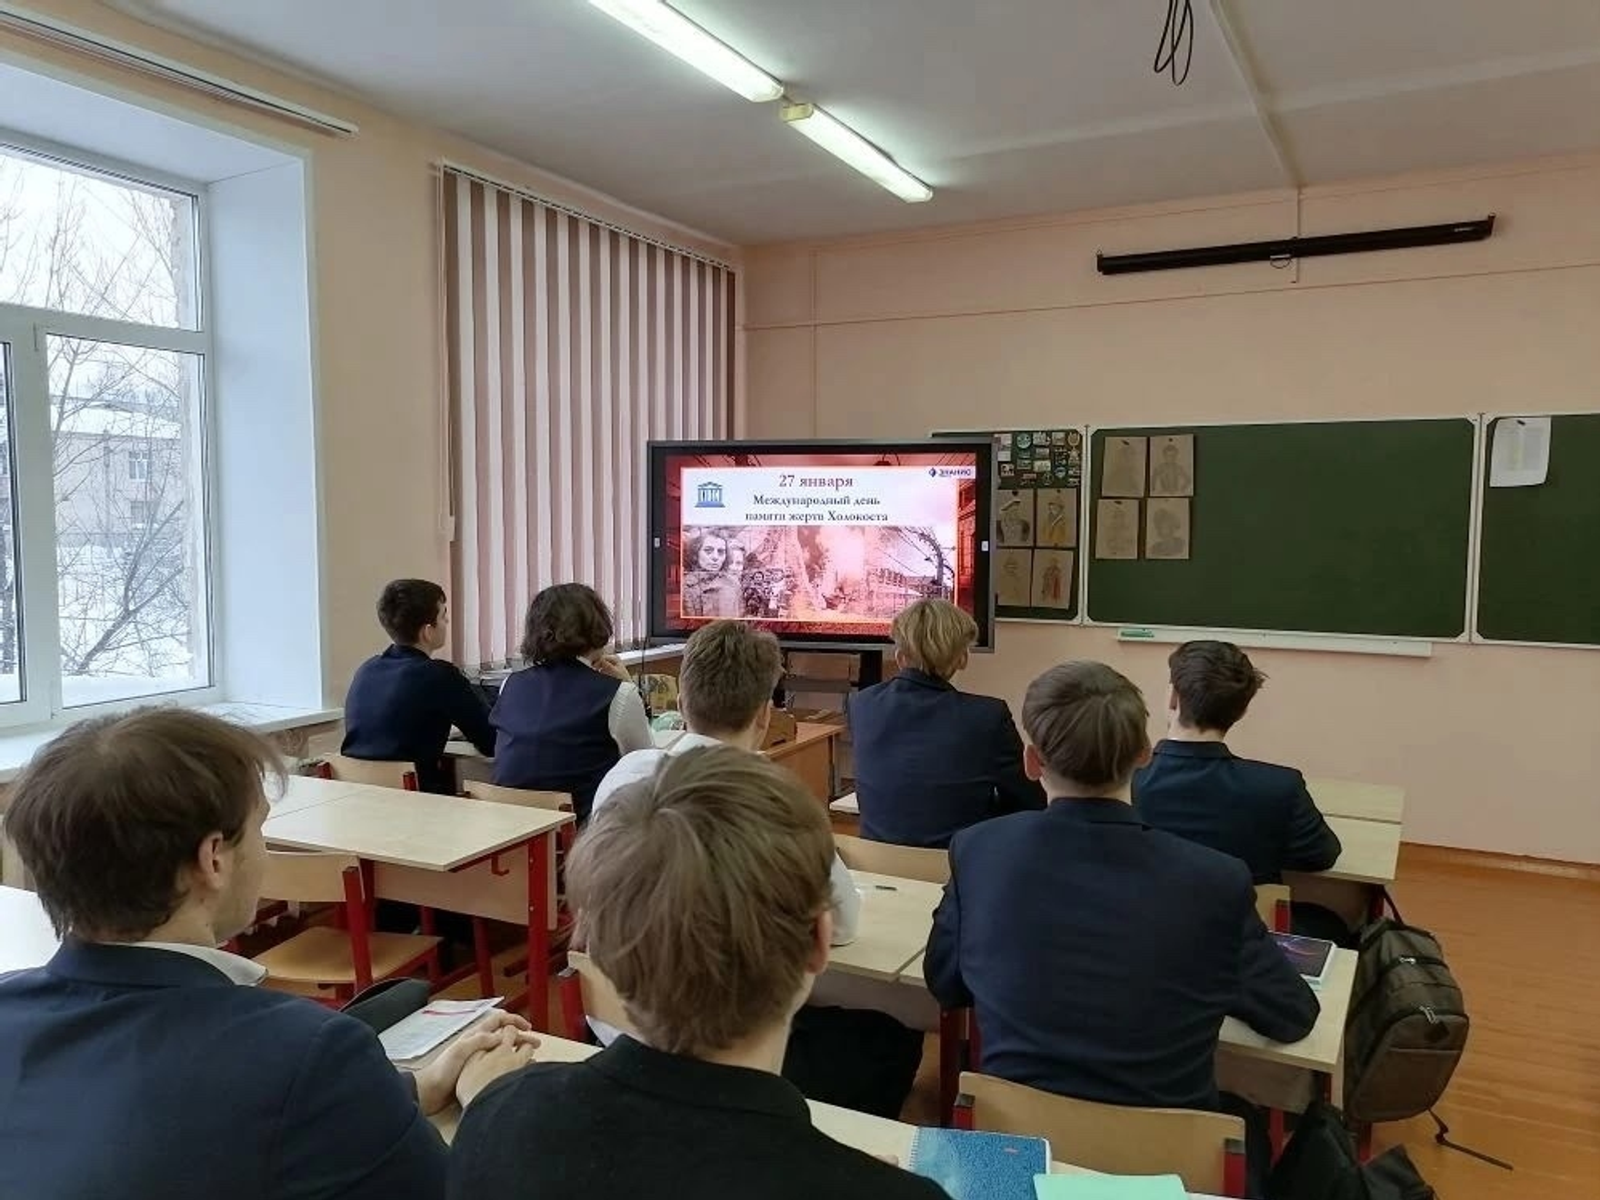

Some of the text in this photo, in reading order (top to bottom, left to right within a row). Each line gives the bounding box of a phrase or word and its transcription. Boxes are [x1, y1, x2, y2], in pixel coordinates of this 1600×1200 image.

[778, 474, 854, 491] 27 января
[752, 494, 882, 508] Международный день
[745, 510, 889, 523] памяти жертв Холокоста
